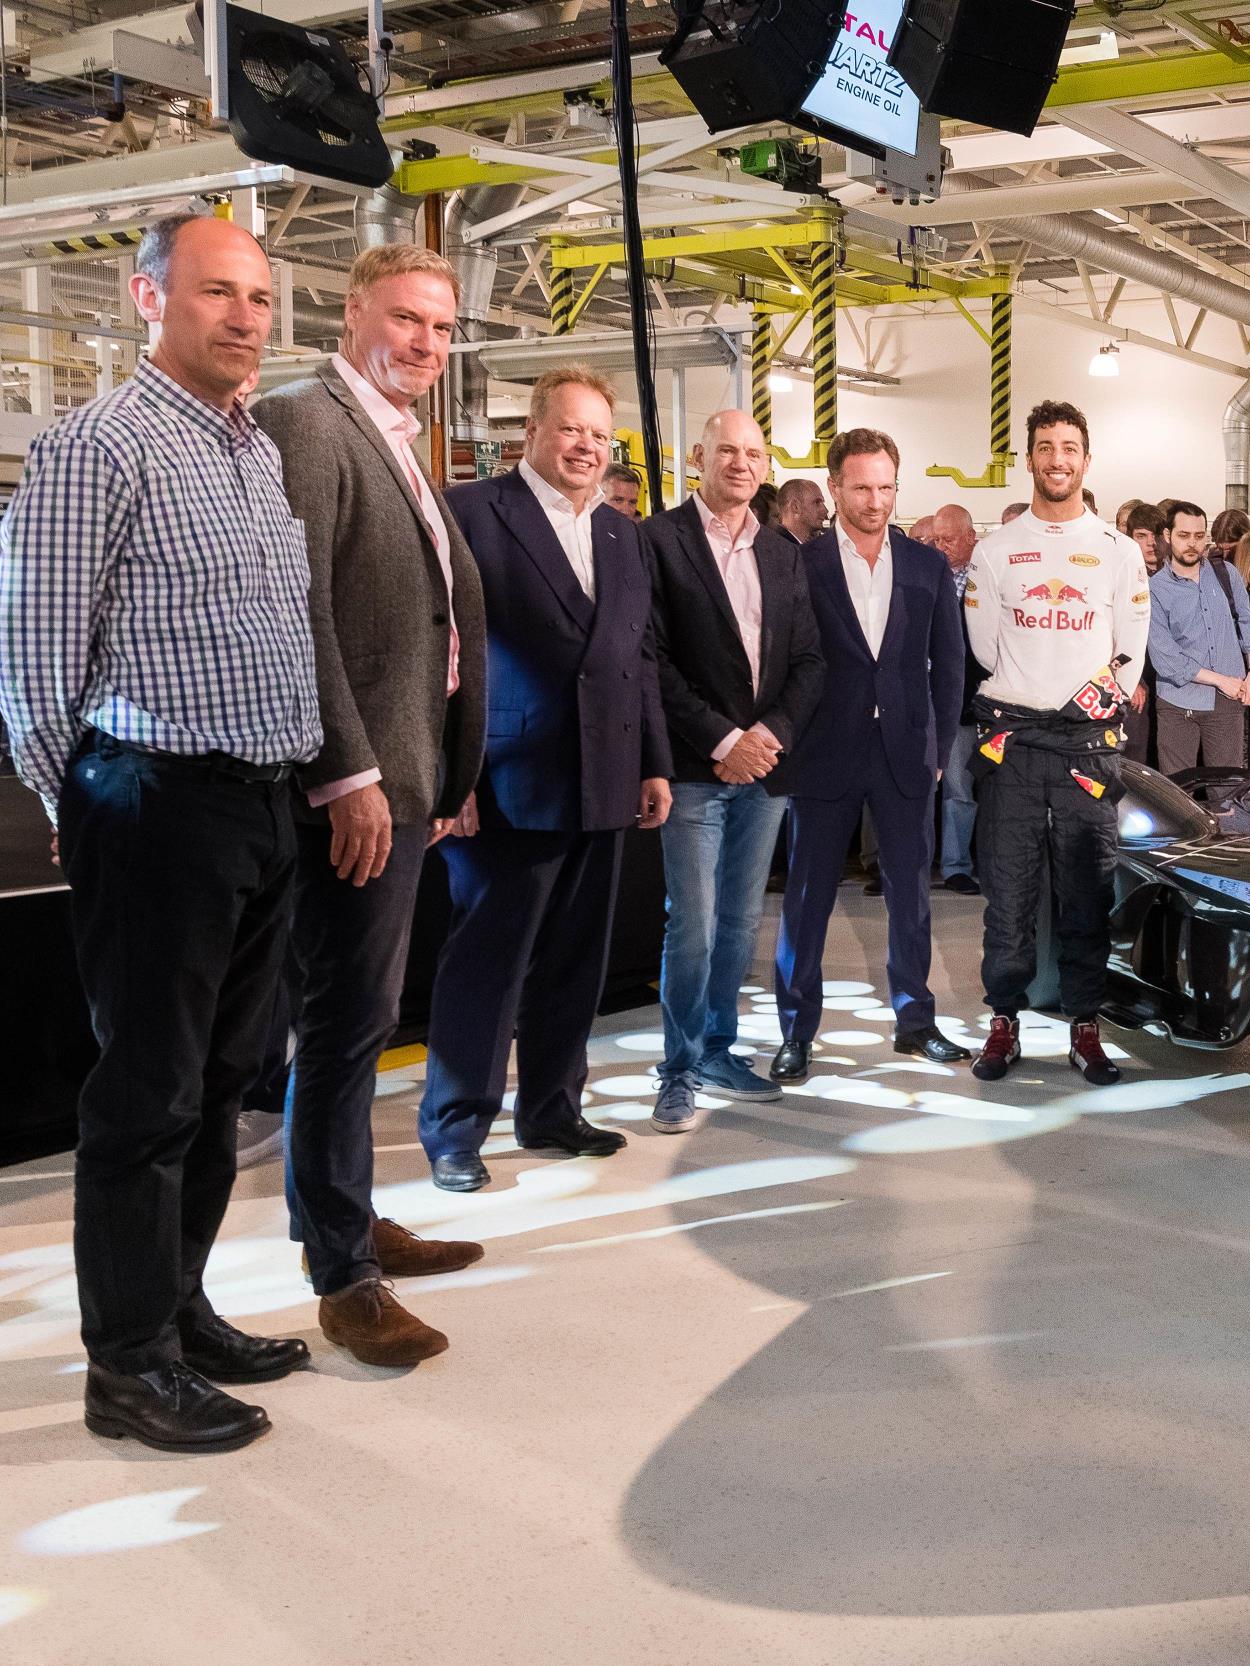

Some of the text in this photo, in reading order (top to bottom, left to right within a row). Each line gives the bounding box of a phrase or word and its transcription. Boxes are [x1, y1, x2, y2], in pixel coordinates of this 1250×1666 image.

[845, 12, 890, 52] TAL
[827, 40, 906, 98] ARTZ
[836, 78, 901, 117] ENGINE OIL
[1013, 608, 1095, 631] Red Bull
[1073, 682, 1118, 720] Bul
